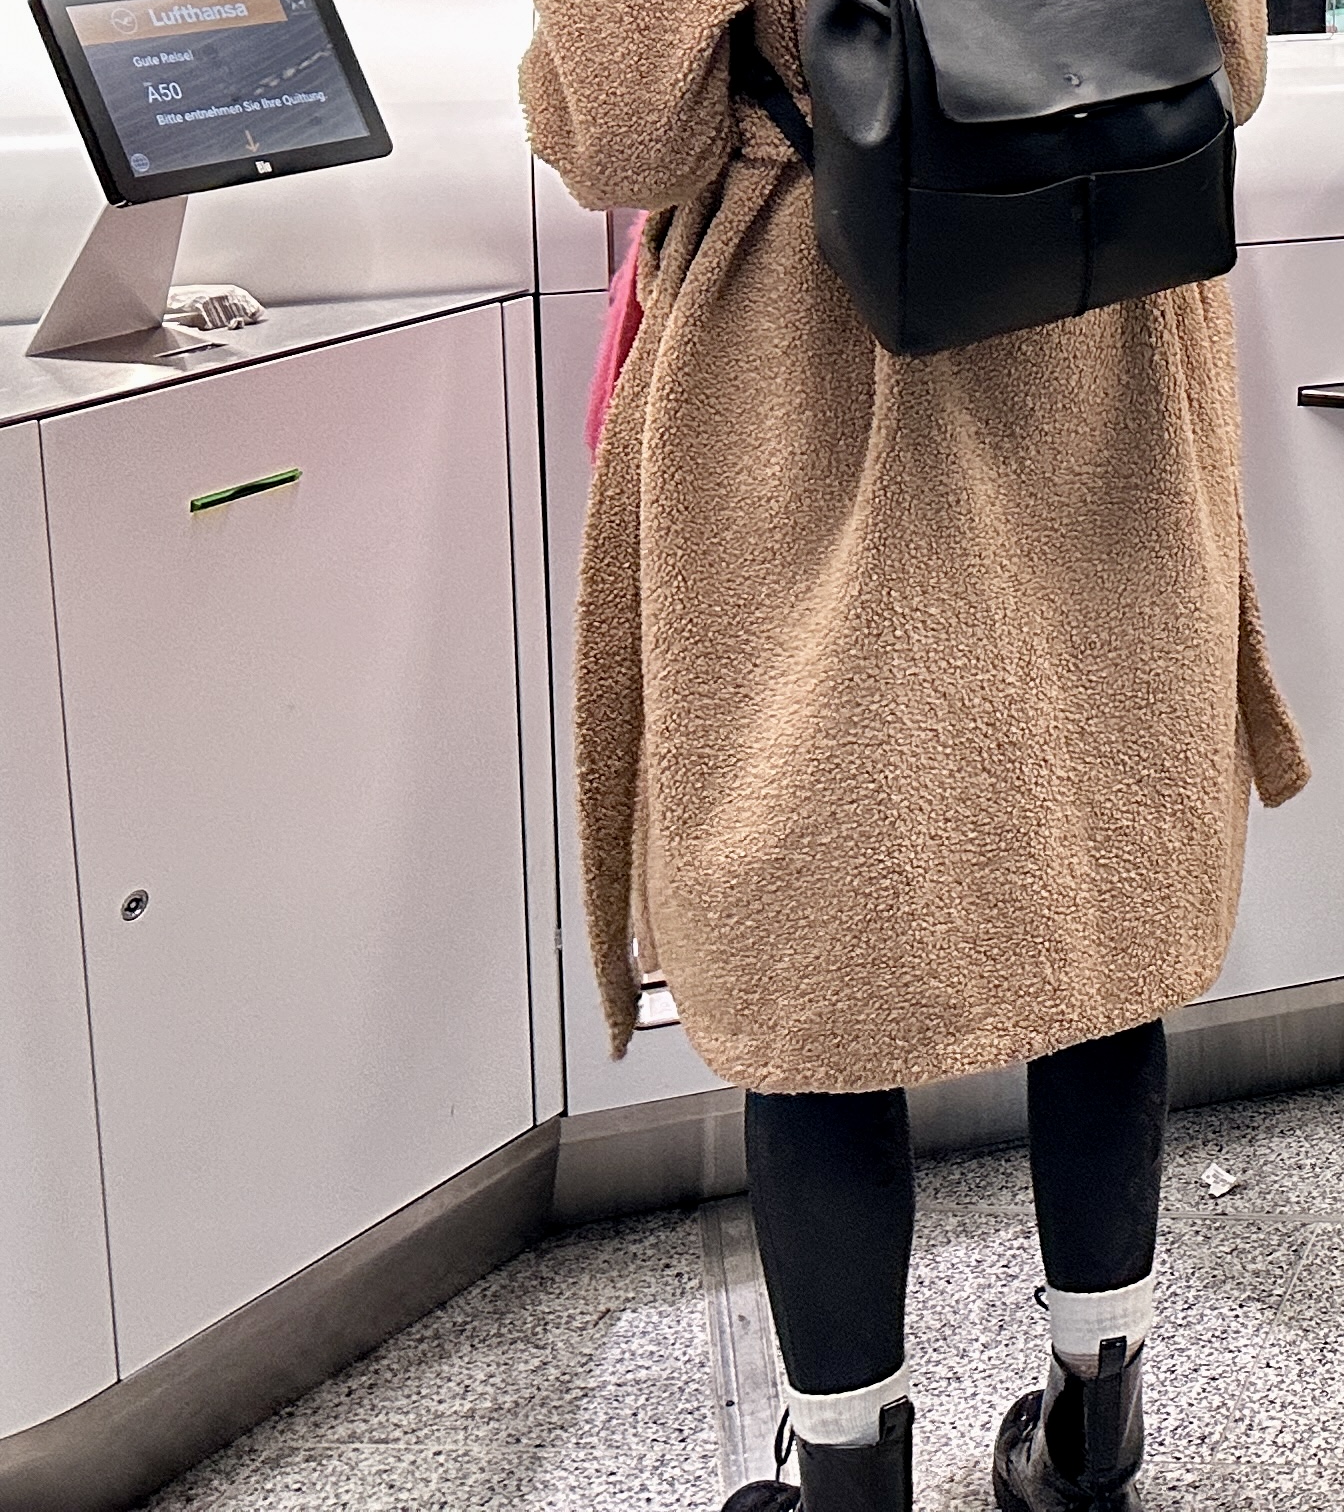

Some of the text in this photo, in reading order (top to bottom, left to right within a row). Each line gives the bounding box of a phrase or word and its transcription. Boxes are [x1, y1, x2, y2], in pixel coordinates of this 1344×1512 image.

[148, 2, 249, 28] Lufthansa
[132, 52, 160, 68] Gute
[148, 82, 183, 104] A50
[156, 112, 184, 126] Bitte
[184, 104, 243, 121] entnehmen
[243, 100, 260, 113] Sie
[261, 97, 283, 110] Ihre
